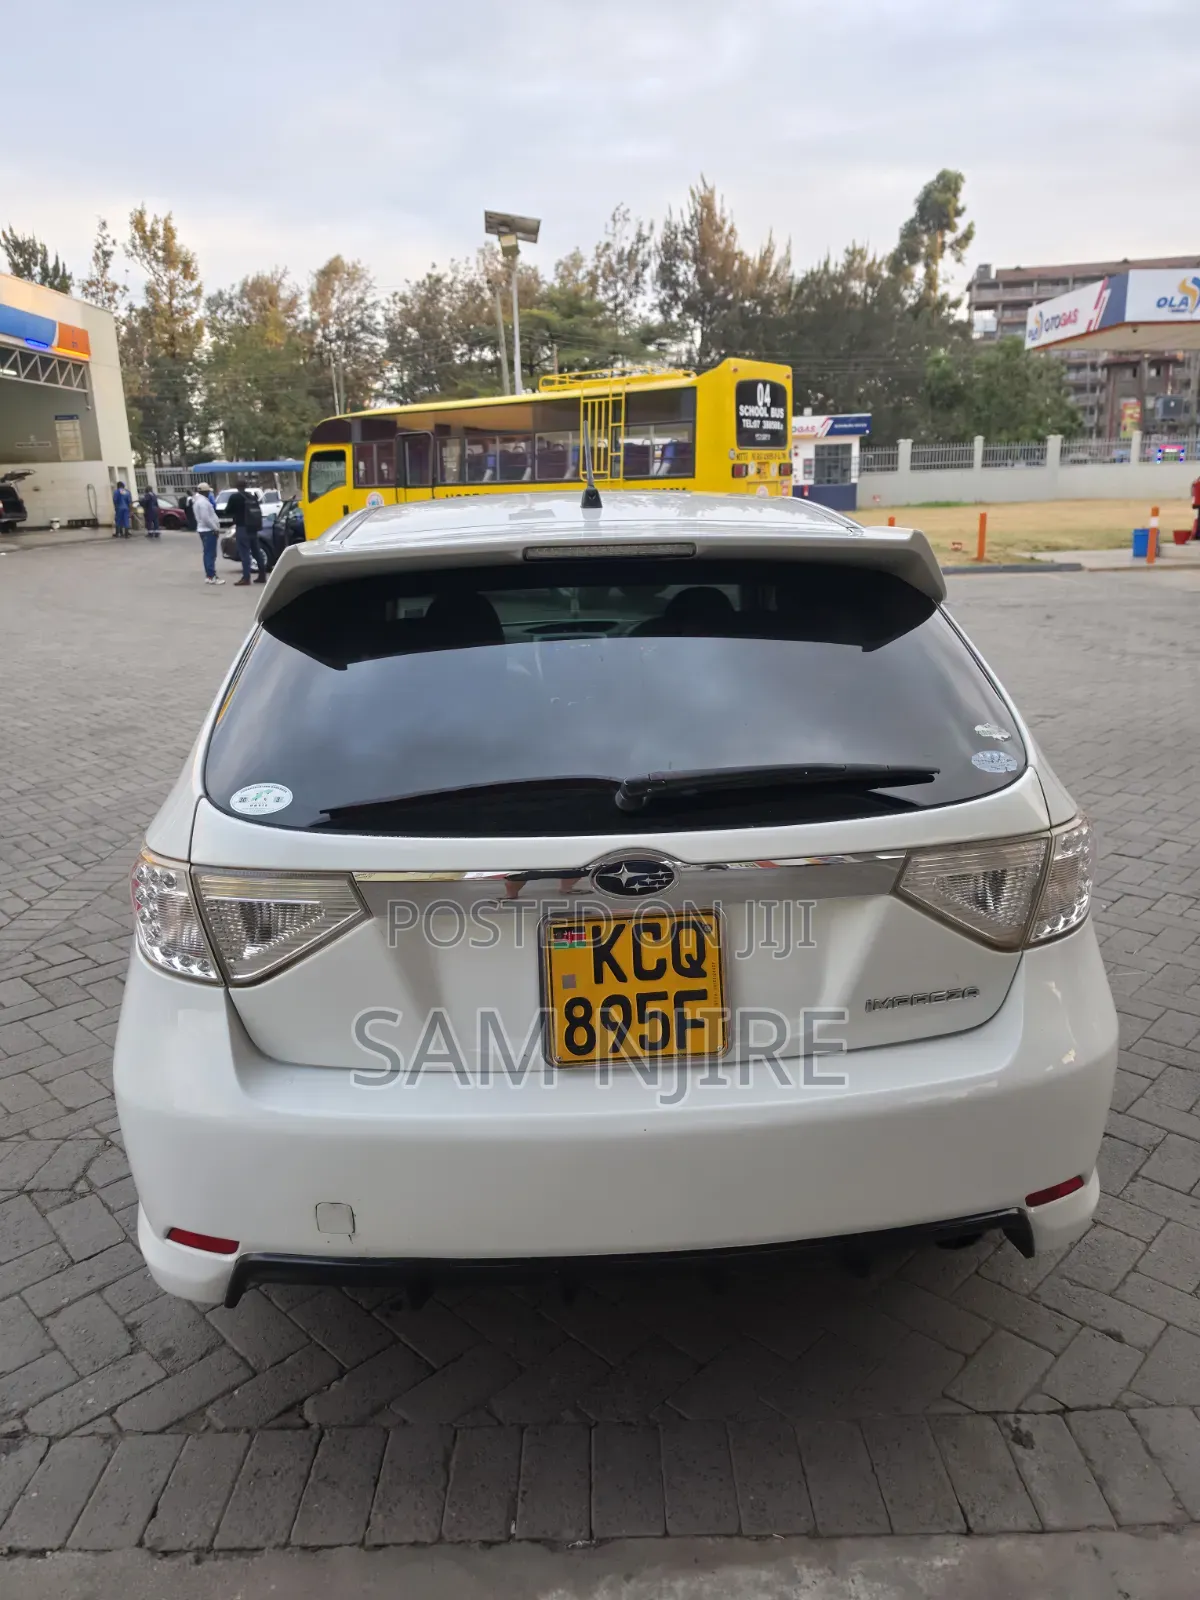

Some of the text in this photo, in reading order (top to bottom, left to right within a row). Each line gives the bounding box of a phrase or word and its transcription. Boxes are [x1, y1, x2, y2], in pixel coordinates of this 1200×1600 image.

[1156, 296, 1189, 308] OLA
[1044, 308, 1079, 332] OTOGAS
[757, 383, 771, 407] 04
[739, 405, 785, 419] SCHOOL BUS
[591, 921, 708, 984] KCQ
[865, 986, 980, 1013] IMPREZA
[564, 989, 708, 1056] 895F
